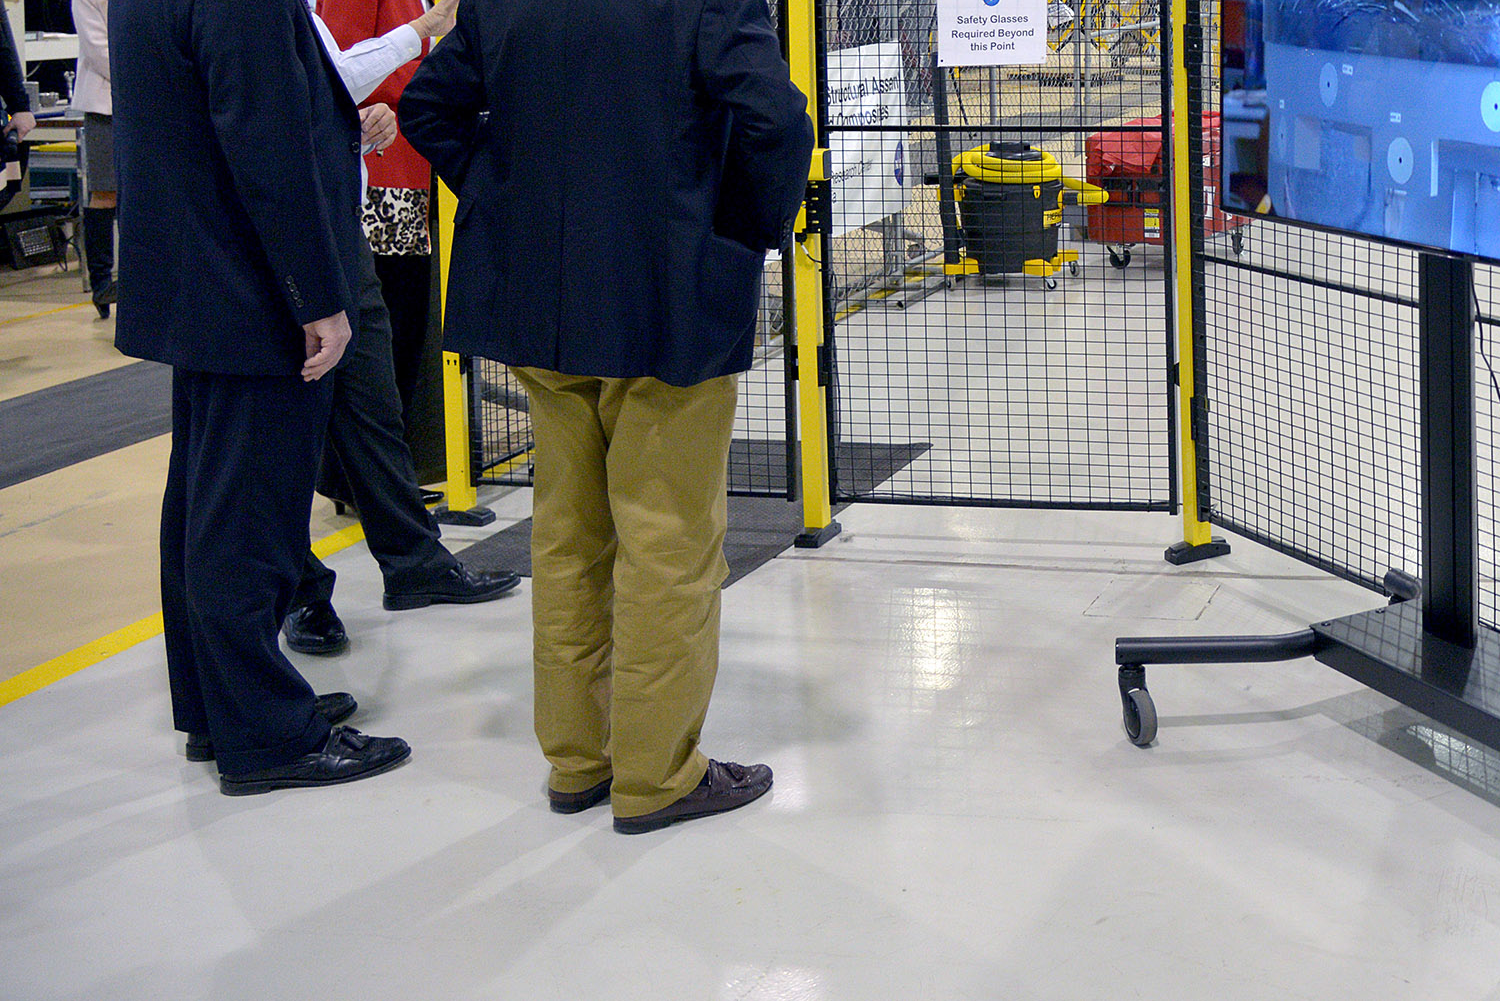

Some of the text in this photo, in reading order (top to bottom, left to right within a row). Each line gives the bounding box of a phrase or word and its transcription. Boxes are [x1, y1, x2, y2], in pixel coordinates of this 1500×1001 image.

[957, 14, 1029, 26] Safety Glasses
[951, 28, 1035, 40] Required Beyond
[970, 42, 1015, 51] this Point
